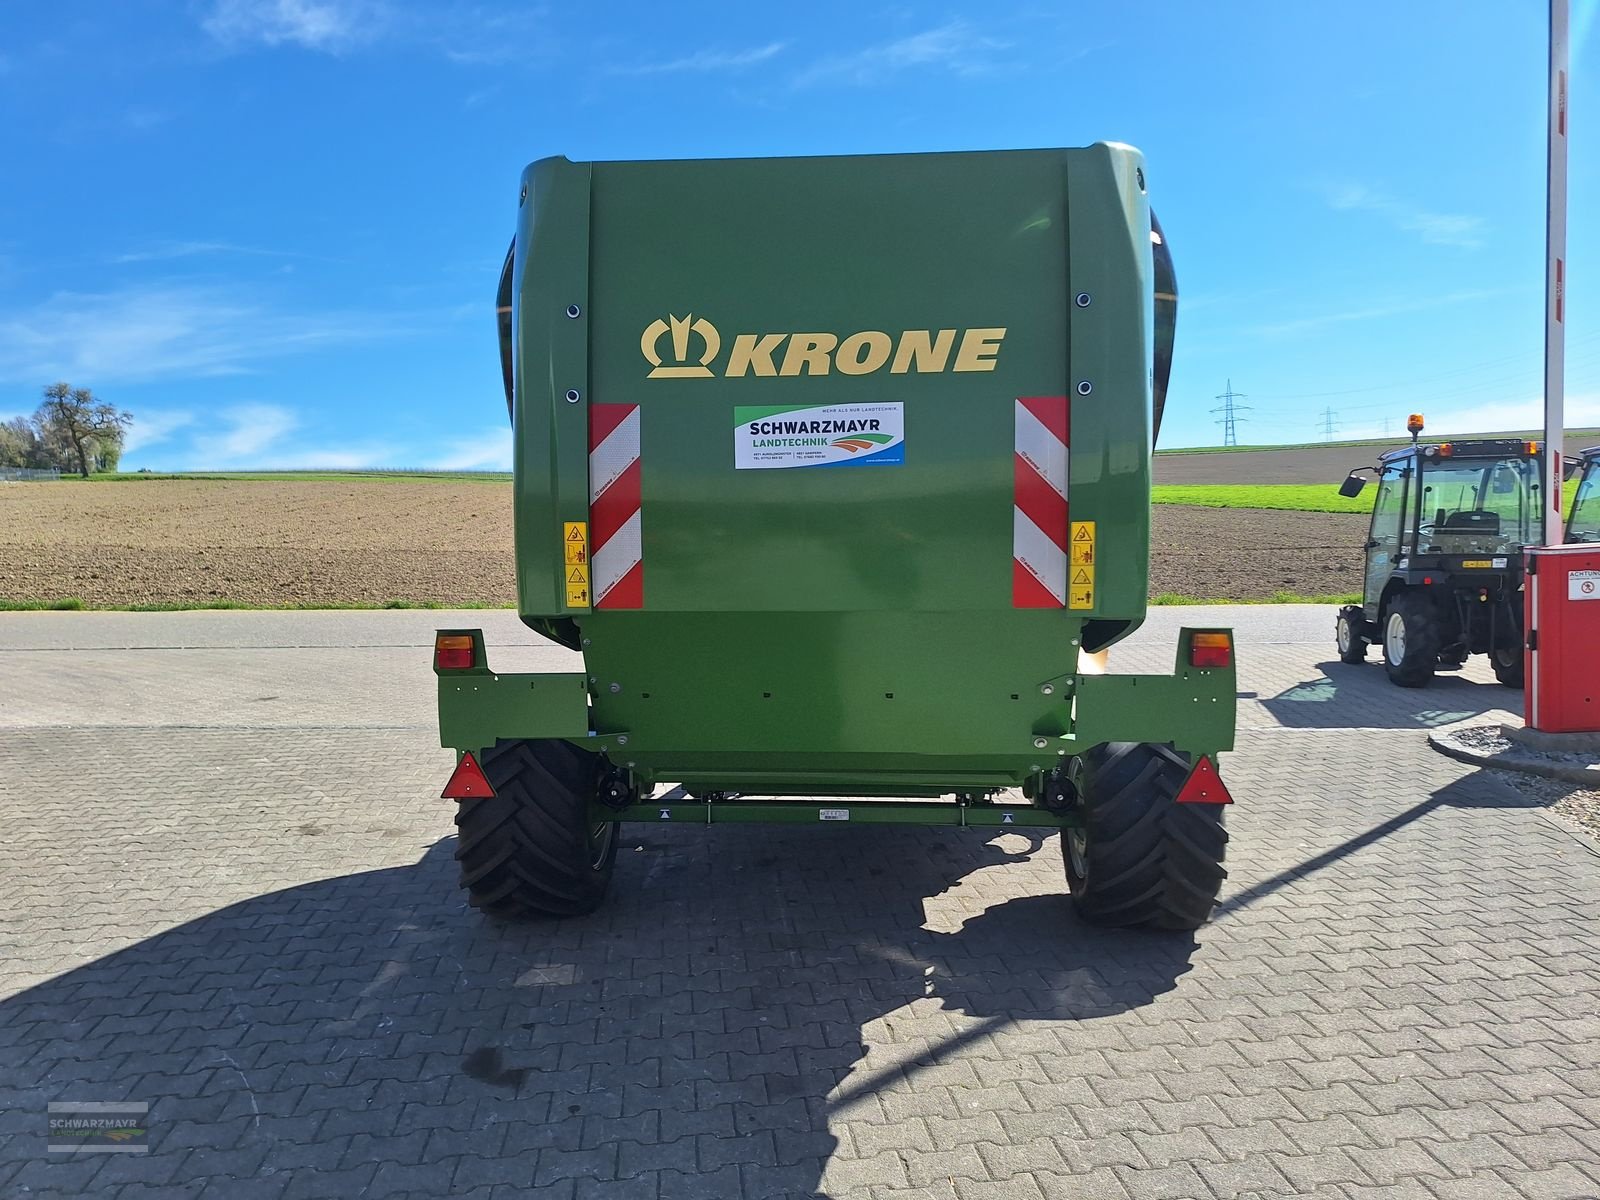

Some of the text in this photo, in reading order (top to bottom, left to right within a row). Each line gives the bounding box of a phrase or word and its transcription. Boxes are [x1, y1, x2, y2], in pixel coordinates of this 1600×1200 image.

[724, 327, 1007, 377] KRONE
[749, 419, 880, 435] SCHWARZMAYR
[752, 437, 828, 448] LANDTECHNIK
